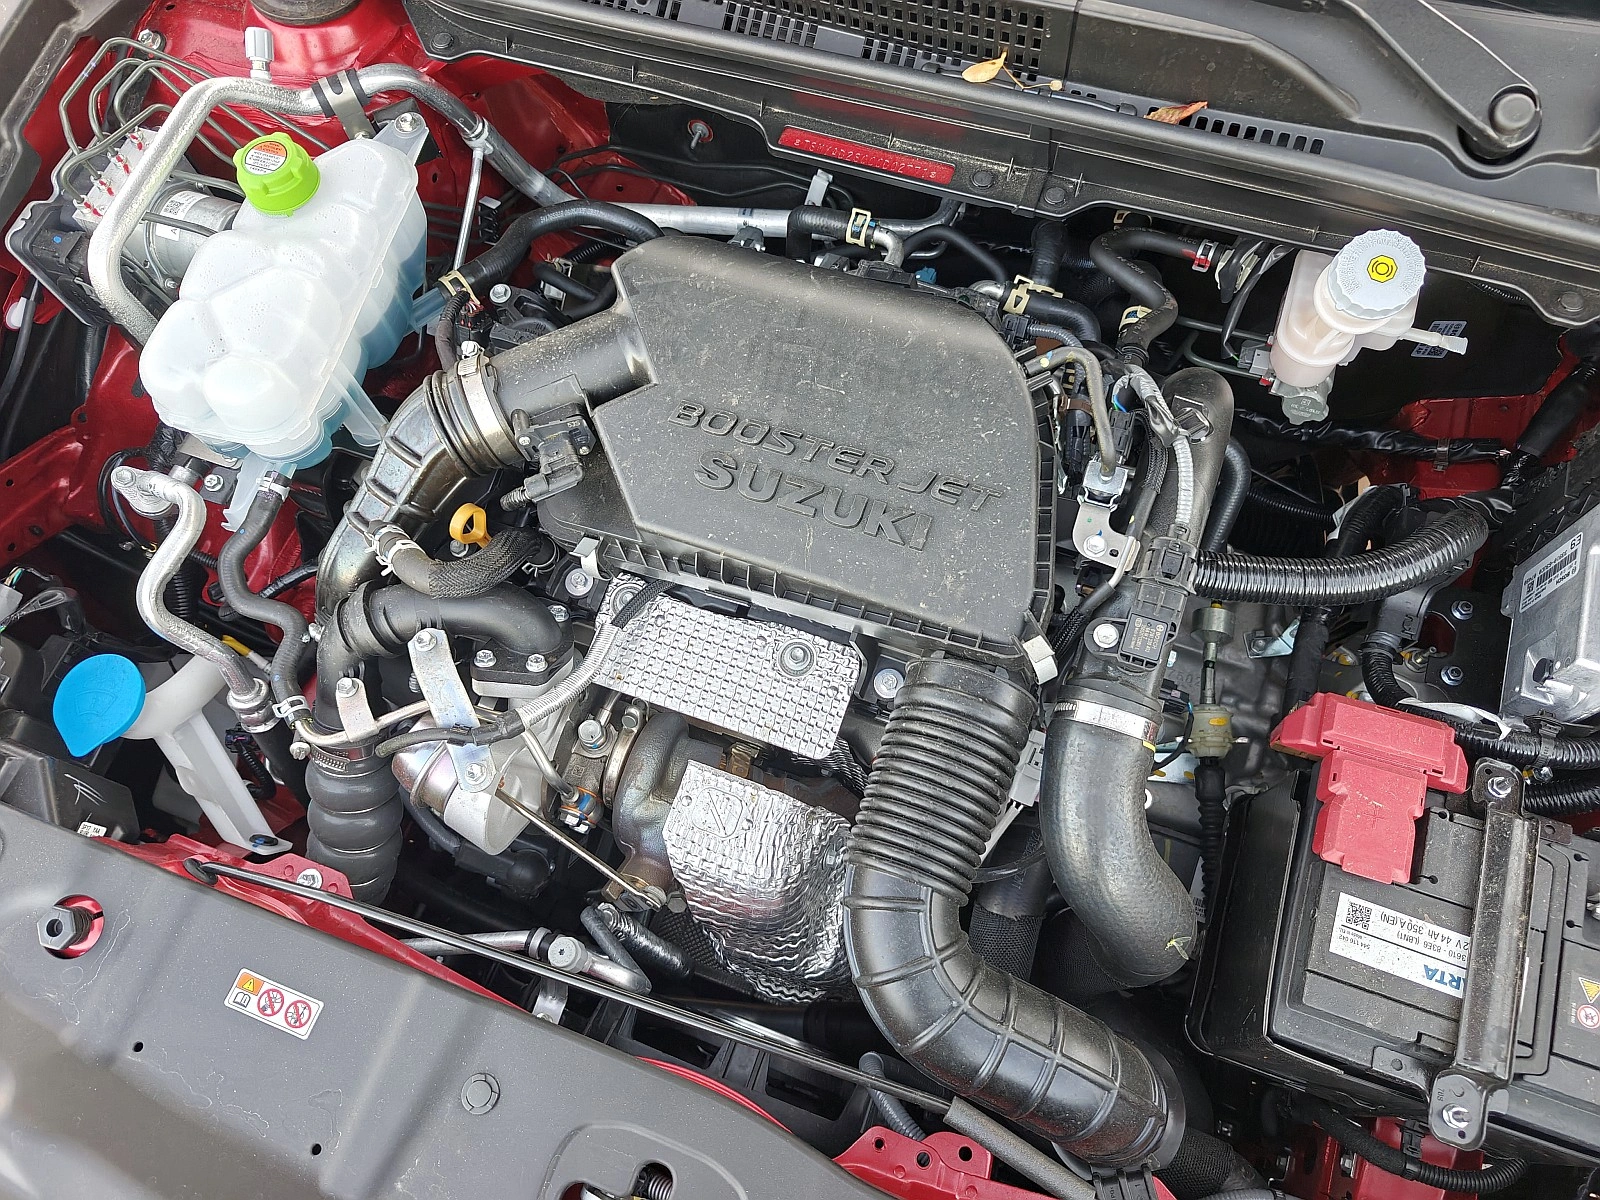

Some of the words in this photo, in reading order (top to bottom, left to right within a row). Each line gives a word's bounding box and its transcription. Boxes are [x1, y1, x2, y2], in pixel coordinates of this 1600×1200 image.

[668, 400, 895, 485] BOOSTER
[898, 471, 1002, 512] JET
[694, 450, 934, 551] SUZUKI
[1570, 534, 1582, 550] E9
[1406, 922, 1425, 935] 350
[1427, 929, 1441, 941] Ah
